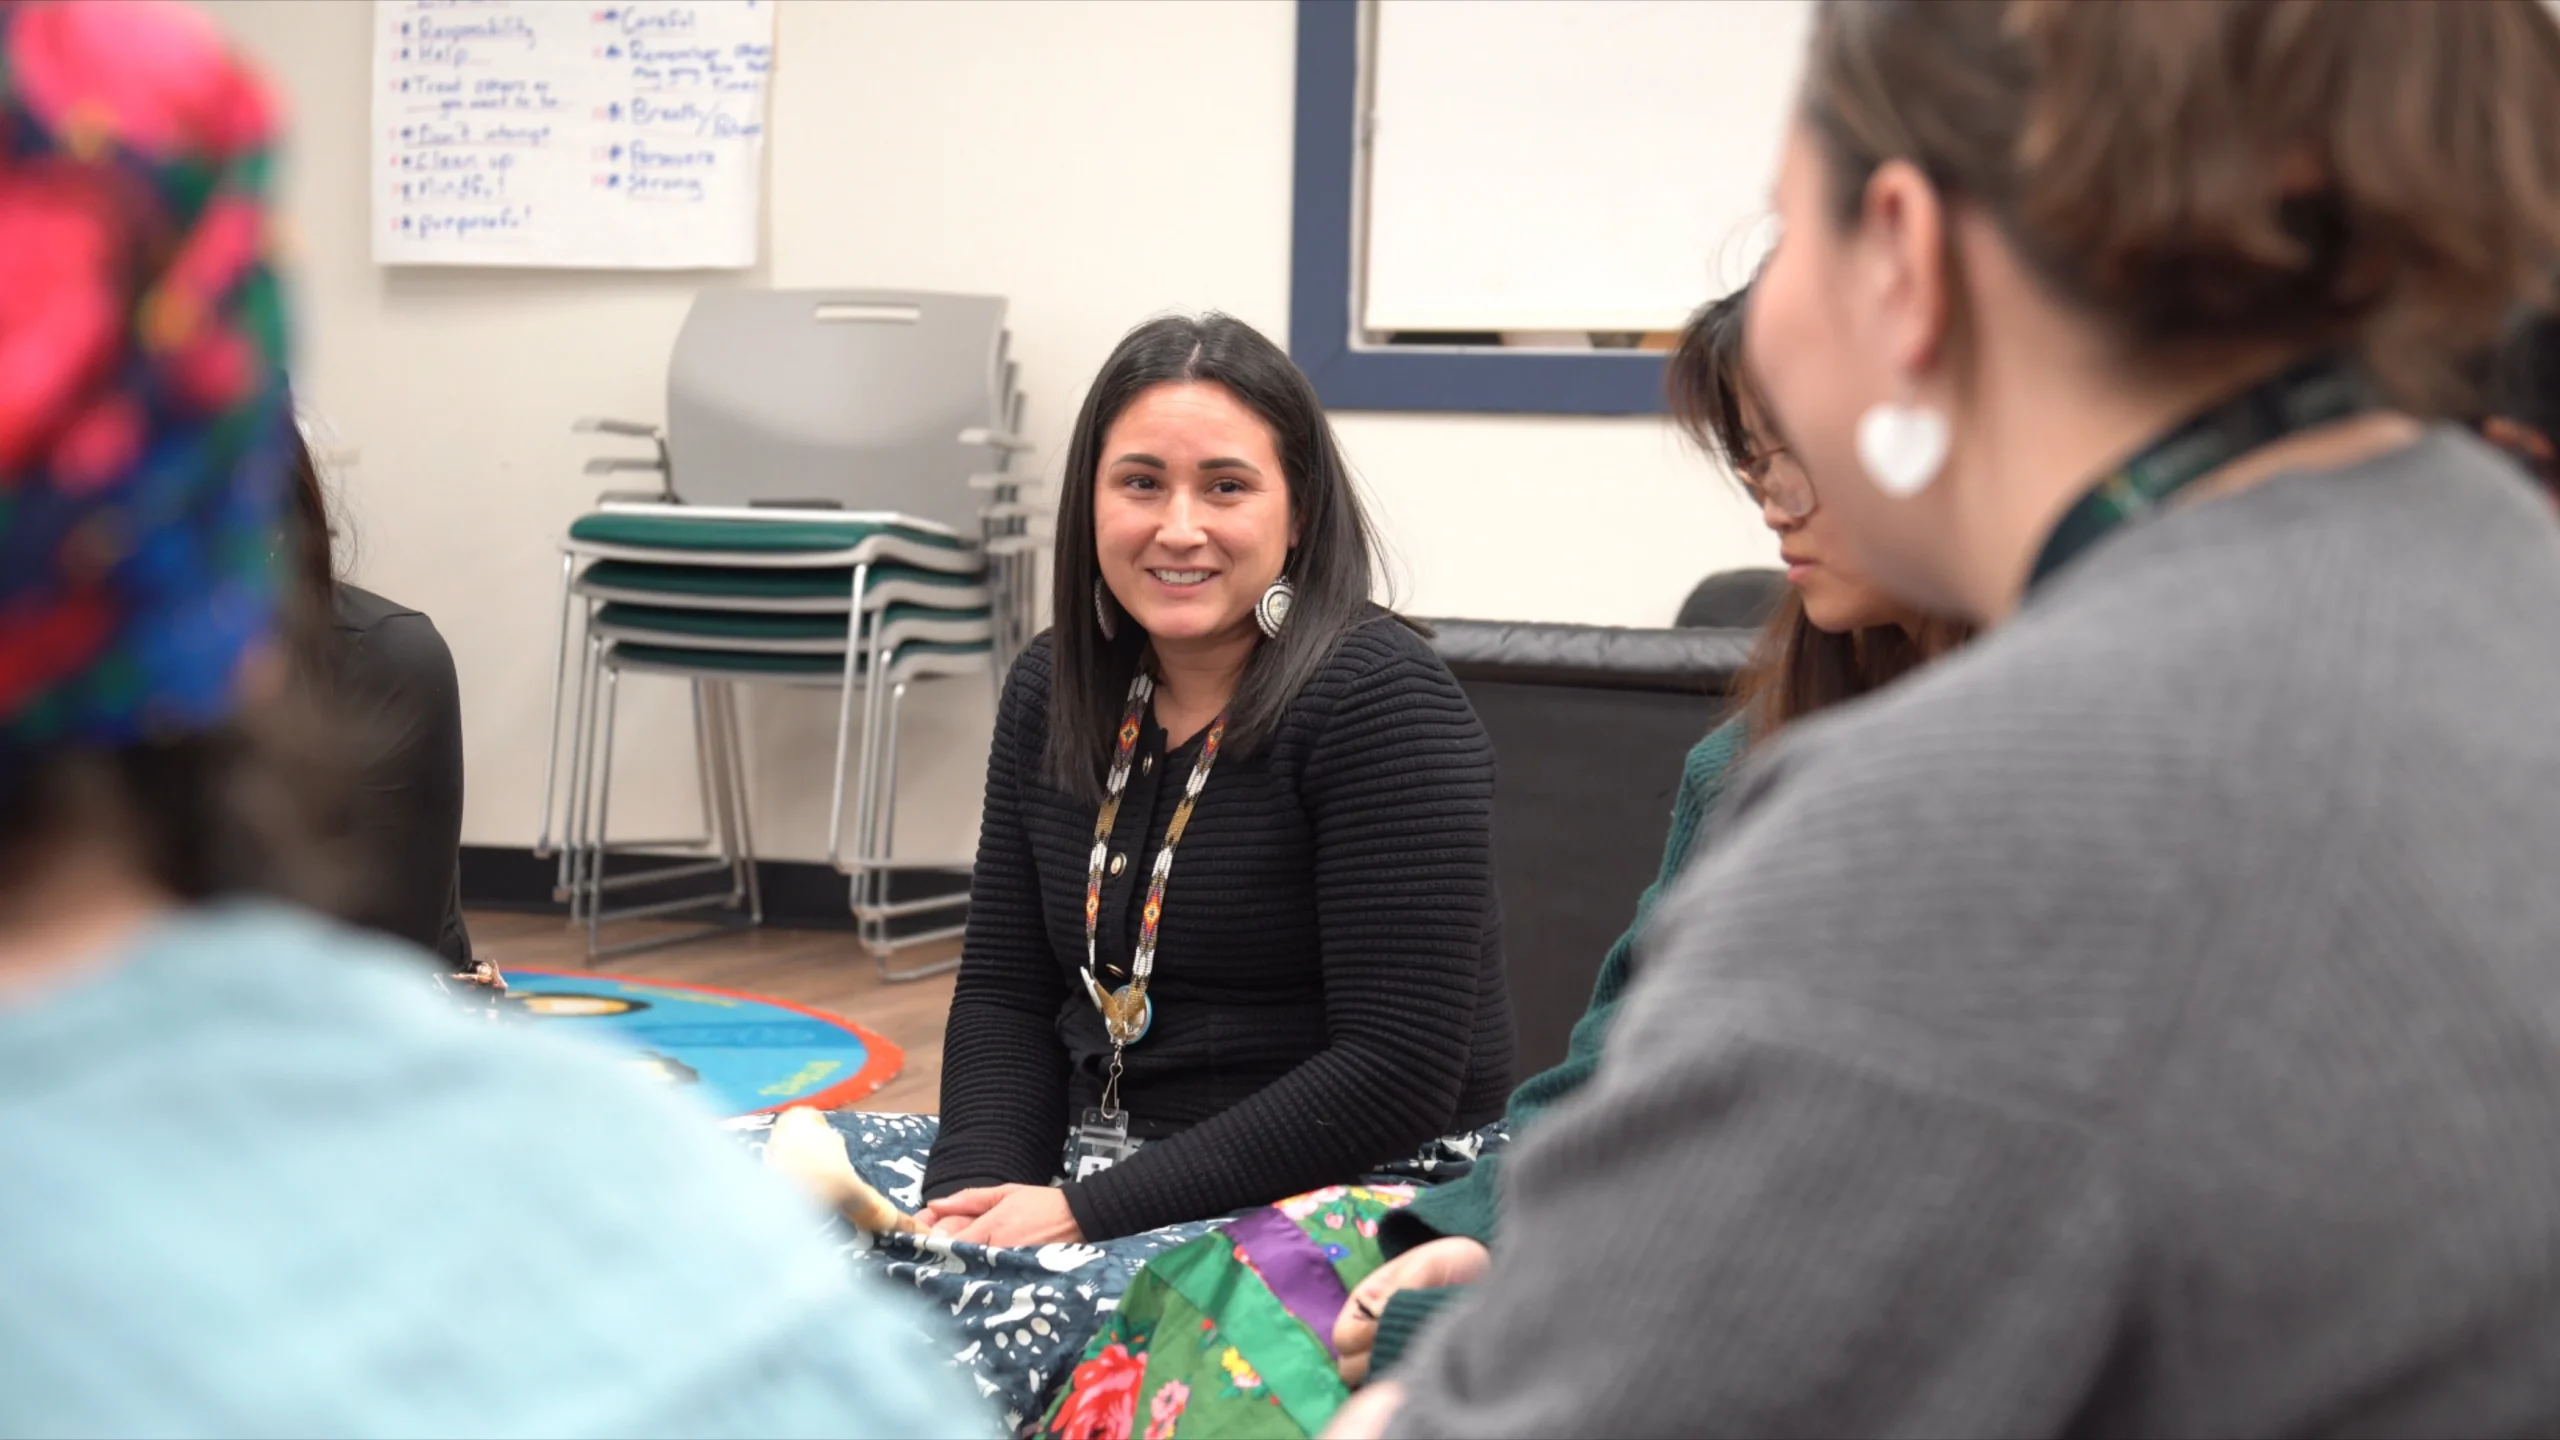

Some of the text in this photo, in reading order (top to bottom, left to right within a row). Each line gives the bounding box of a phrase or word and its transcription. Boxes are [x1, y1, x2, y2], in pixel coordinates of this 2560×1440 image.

[418, 15, 537, 51] Responsibility
[418, 43, 468, 69] Help
[630, 40, 719, 60] Remember
[627, 172, 704, 201] Strong
